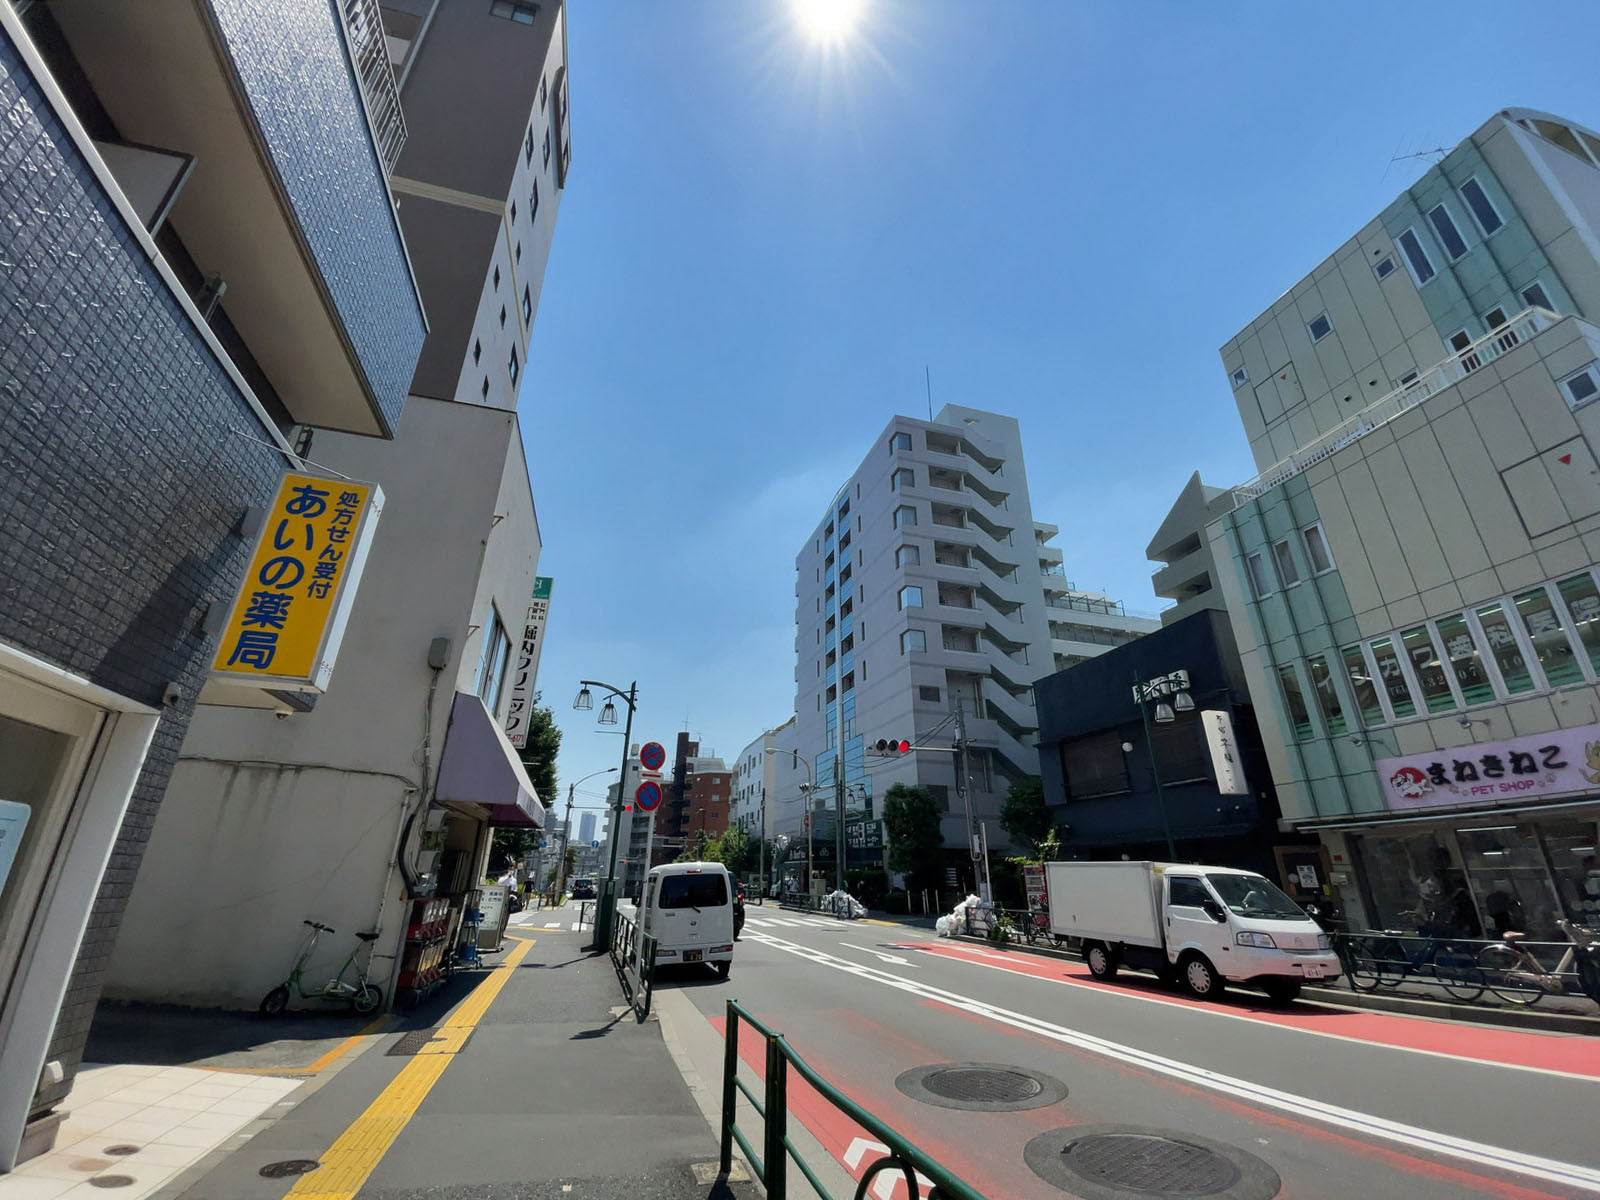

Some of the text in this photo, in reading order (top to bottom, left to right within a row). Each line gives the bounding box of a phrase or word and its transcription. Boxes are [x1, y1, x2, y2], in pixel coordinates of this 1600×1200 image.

[227, 484, 330, 669] あいの薬局
[306, 491, 360, 599] 処方せん受付
[1426, 745, 1568, 785] まねきねこ
[1471, 779, 1535, 796] PET SHOP
